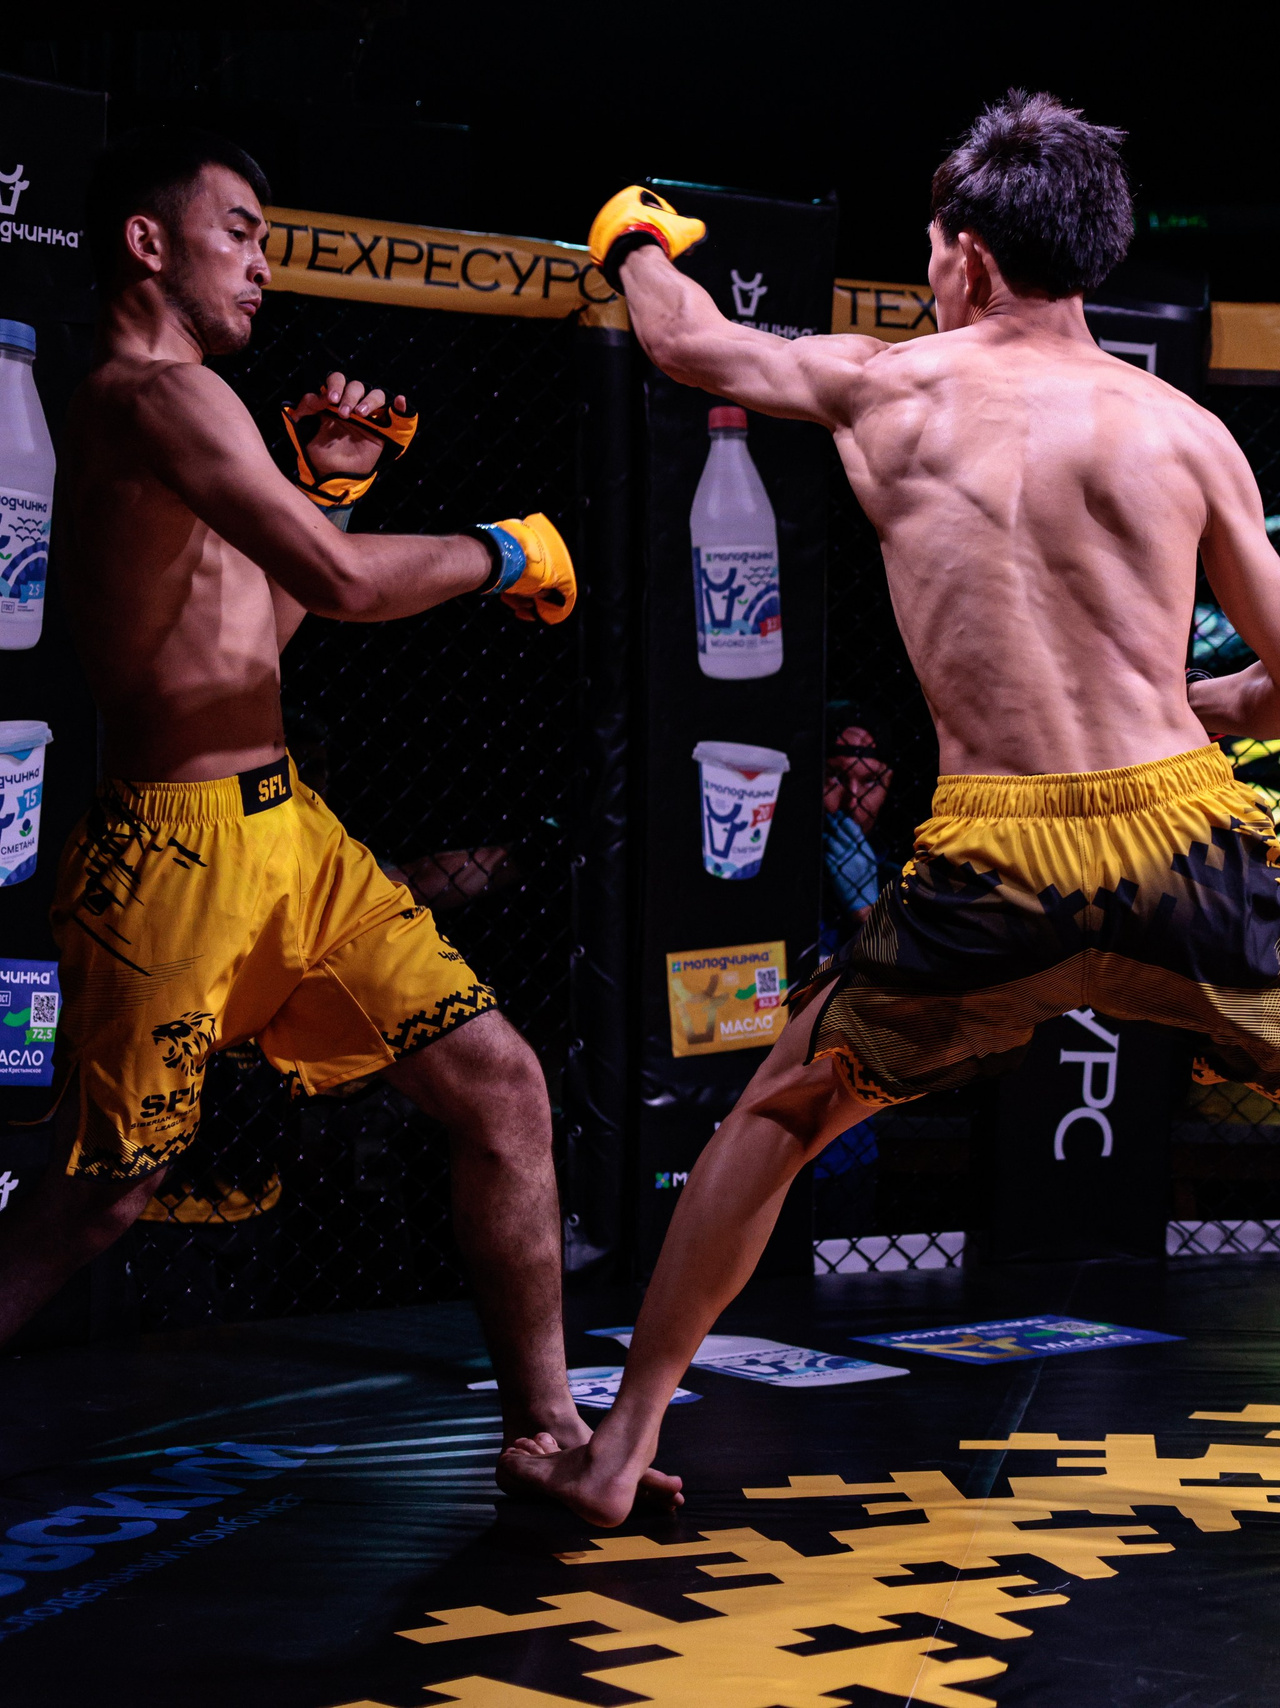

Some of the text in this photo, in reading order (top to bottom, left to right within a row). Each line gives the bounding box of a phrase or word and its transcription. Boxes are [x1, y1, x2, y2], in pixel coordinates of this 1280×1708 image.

[0, 221, 79, 249] дчинка
[265, 220, 620, 303] ТЕХРЕСУРС
[836, 286, 938, 330] ТЕХ
[0, 496, 48, 513] одчинка
[0, 766, 40, 789] дчинка
[24, 788, 38, 808] 15
[258, 774, 287, 803] SFL
[0, 970, 51, 985] чинка
[32, 1028, 53, 1041] 72,5
[720, 1015, 774, 1035] МАСЛО
[0, 1049, 44, 1066] АСЛО
[1059, 1006, 1120, 1161] УРС
[130, 1114, 172, 1129] SIBERIAN
[155, 1117, 187, 1132] LEAGUE
[0, 1441, 341, 1597] вский
